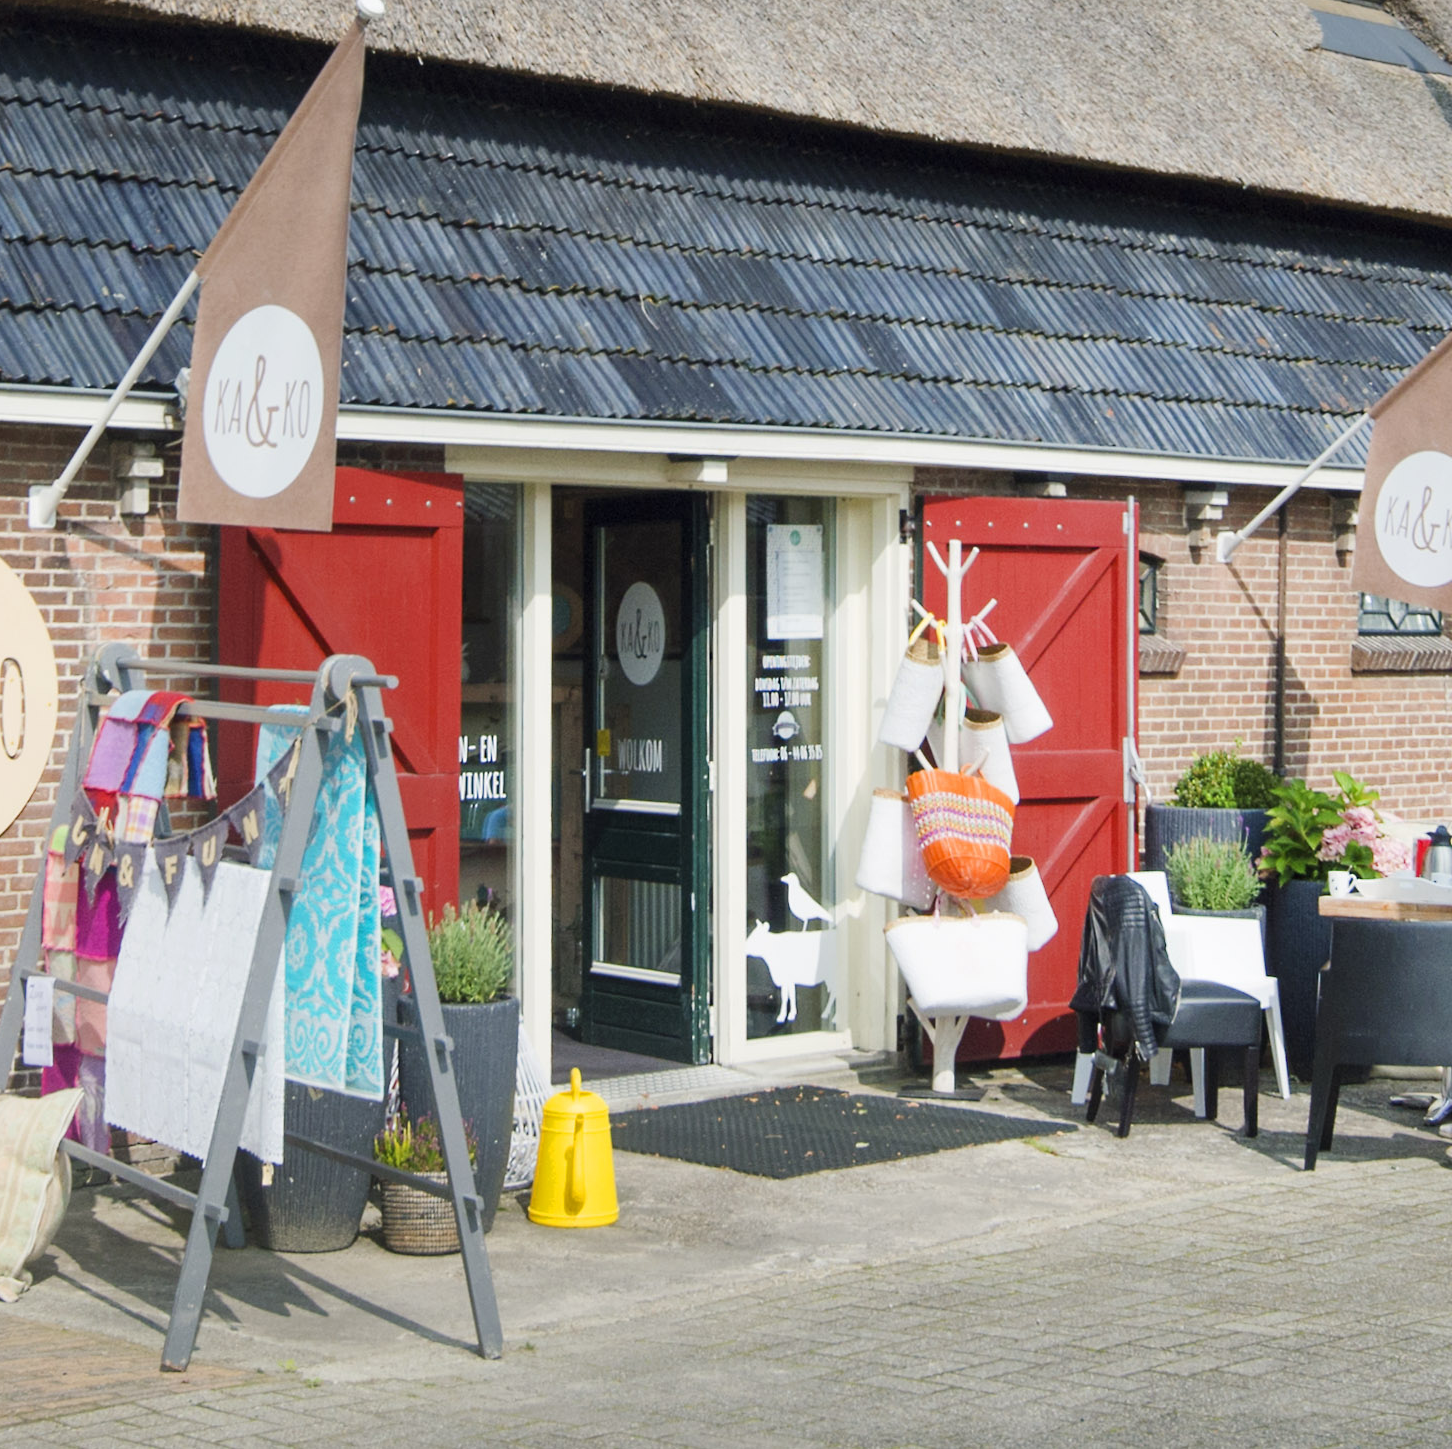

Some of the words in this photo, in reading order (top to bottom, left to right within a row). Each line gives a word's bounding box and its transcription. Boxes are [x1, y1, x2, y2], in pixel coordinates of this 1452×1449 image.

[214, 354, 311, 448] KA&KO
[620, 608, 660, 659] KA&KO
[480, 735, 497, 763] EN
[618, 738, 663, 773] WOLKOM
